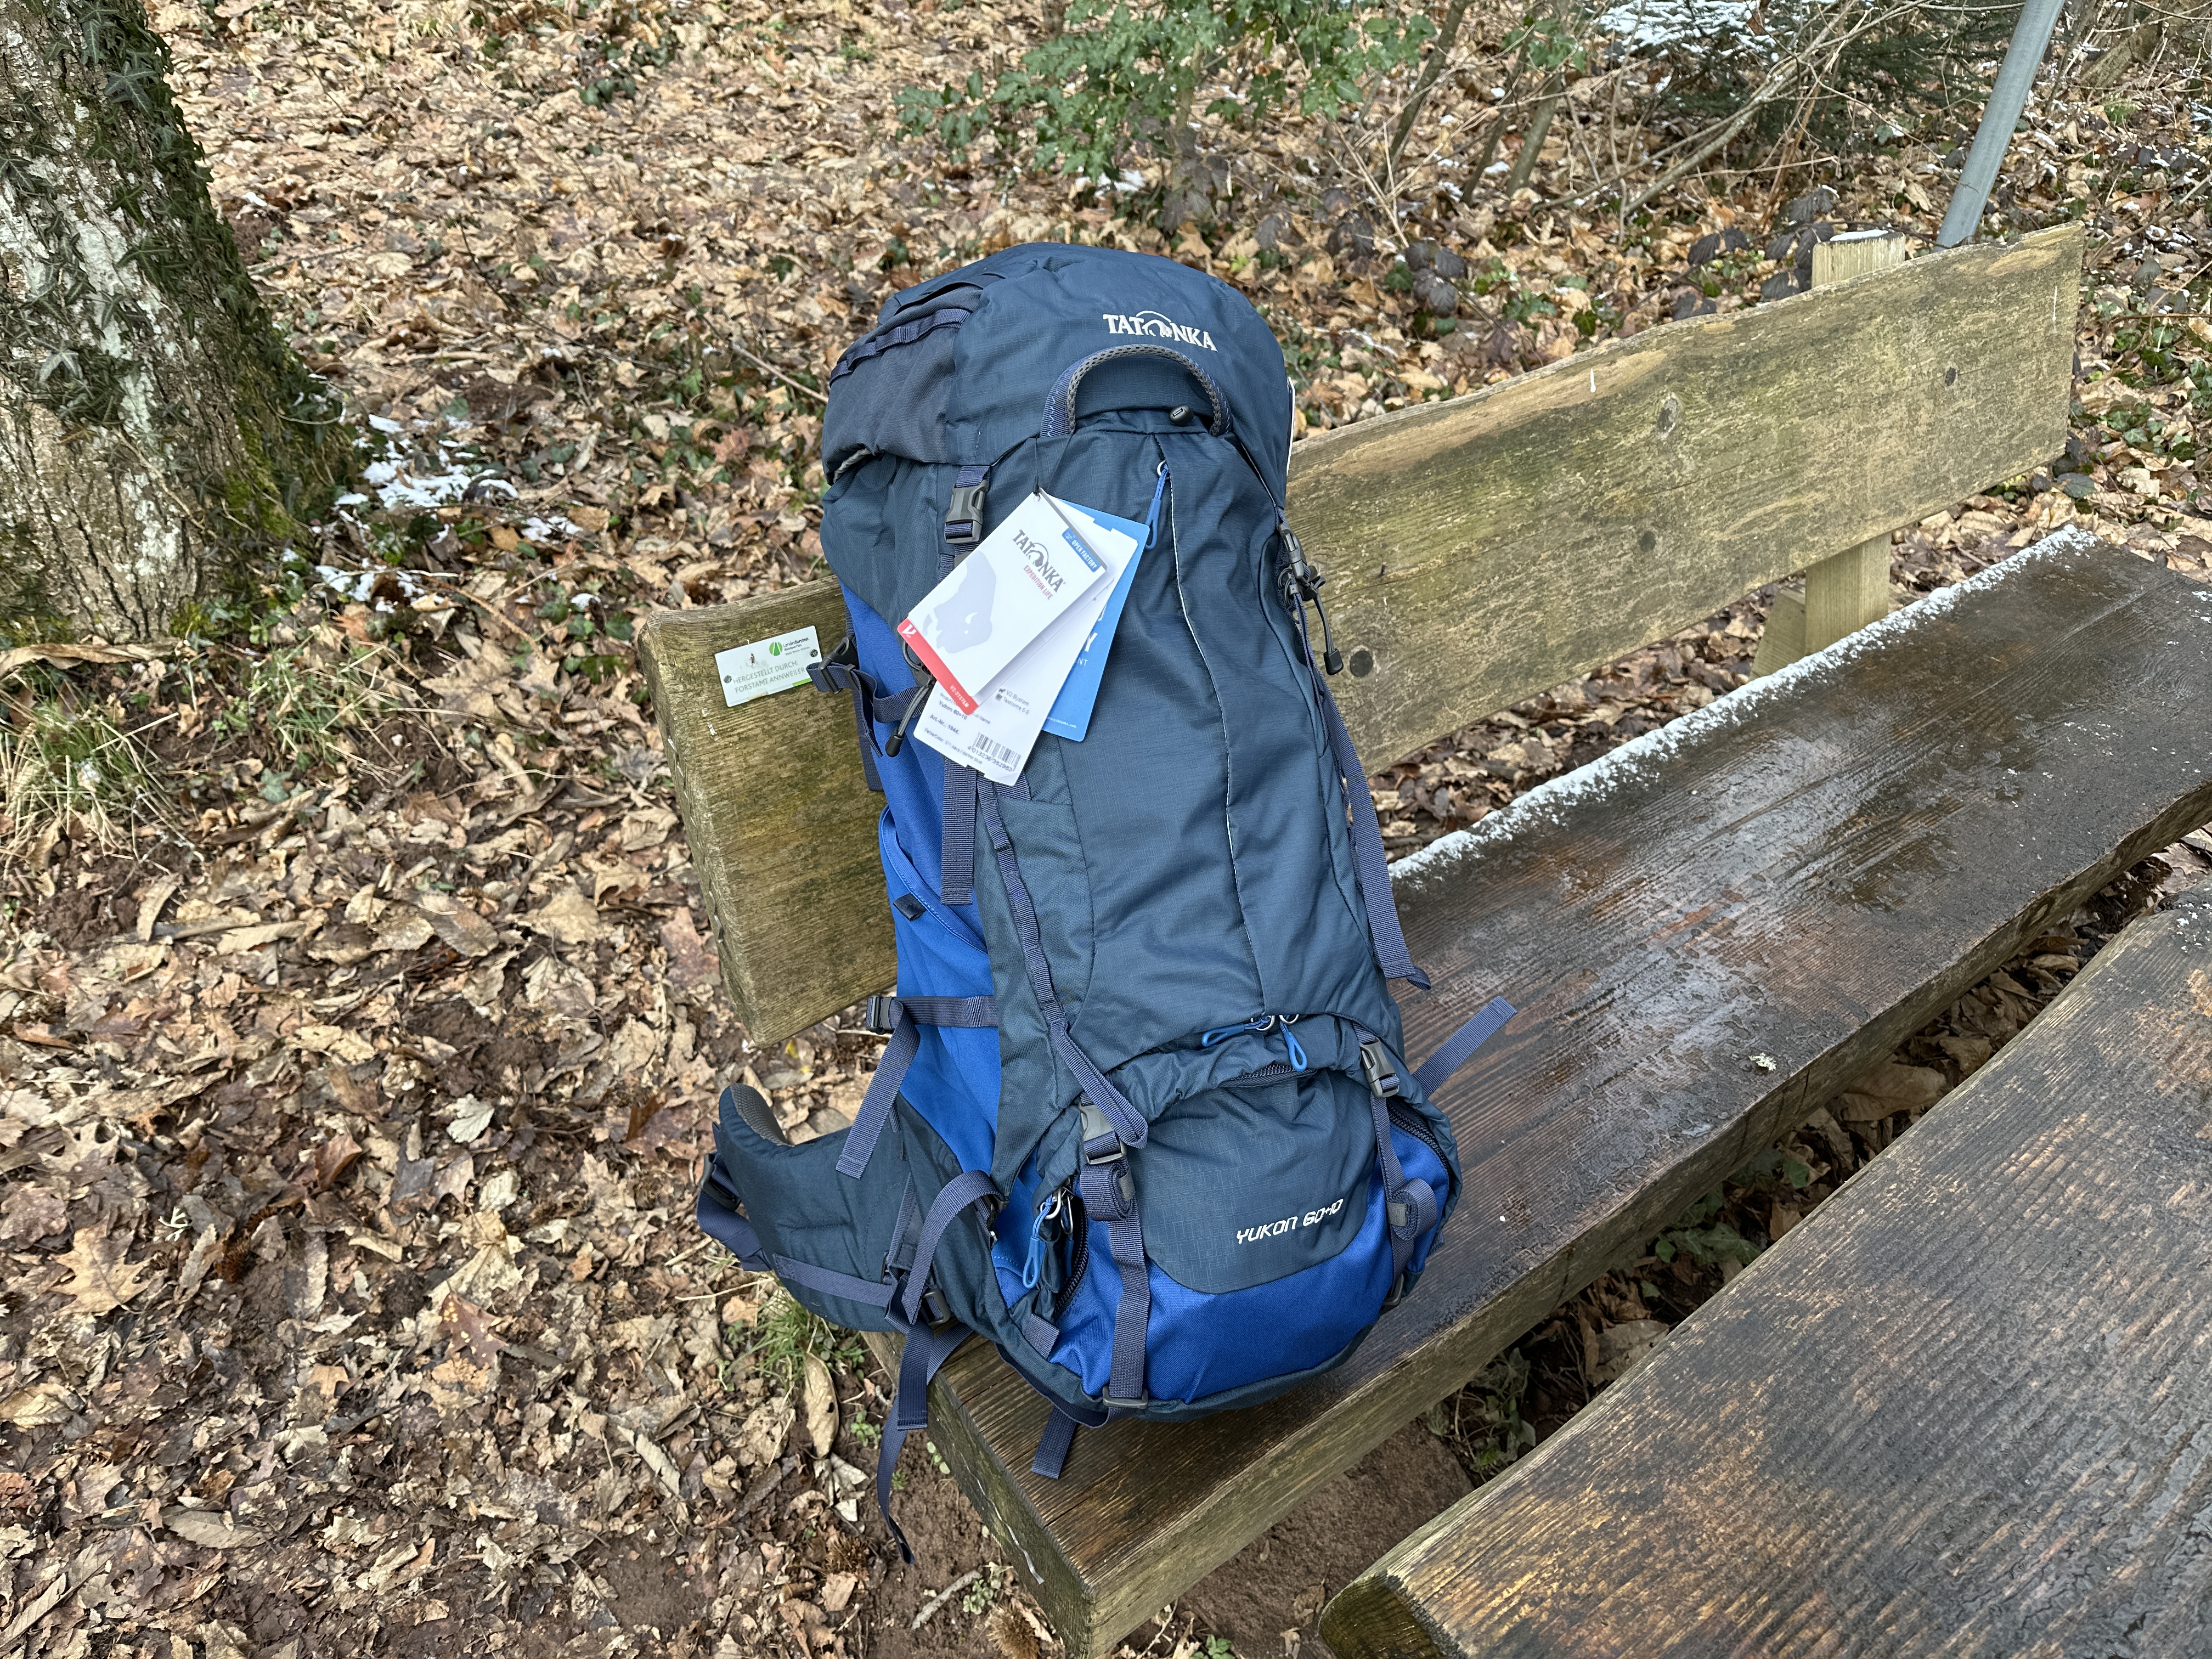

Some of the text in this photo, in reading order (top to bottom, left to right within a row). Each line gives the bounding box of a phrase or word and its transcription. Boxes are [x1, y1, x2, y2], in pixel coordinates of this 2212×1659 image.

[1103, 311, 1218, 352] TATONKA
[1013, 529, 1064, 592] TATONKA
[1071, 540, 1098, 569] OPEN FACTORY
[1024, 565, 1053, 600] EXPEDITION LIFE
[733, 667, 774, 685] HERGESTELLT
[735, 667, 805, 693] FORSTAMT ANNWEILER
[939, 700, 952, 713] Yukon
[950, 685, 969, 708] V2-SYSTEM
[1237, 1216, 1299, 1244] YUKON
